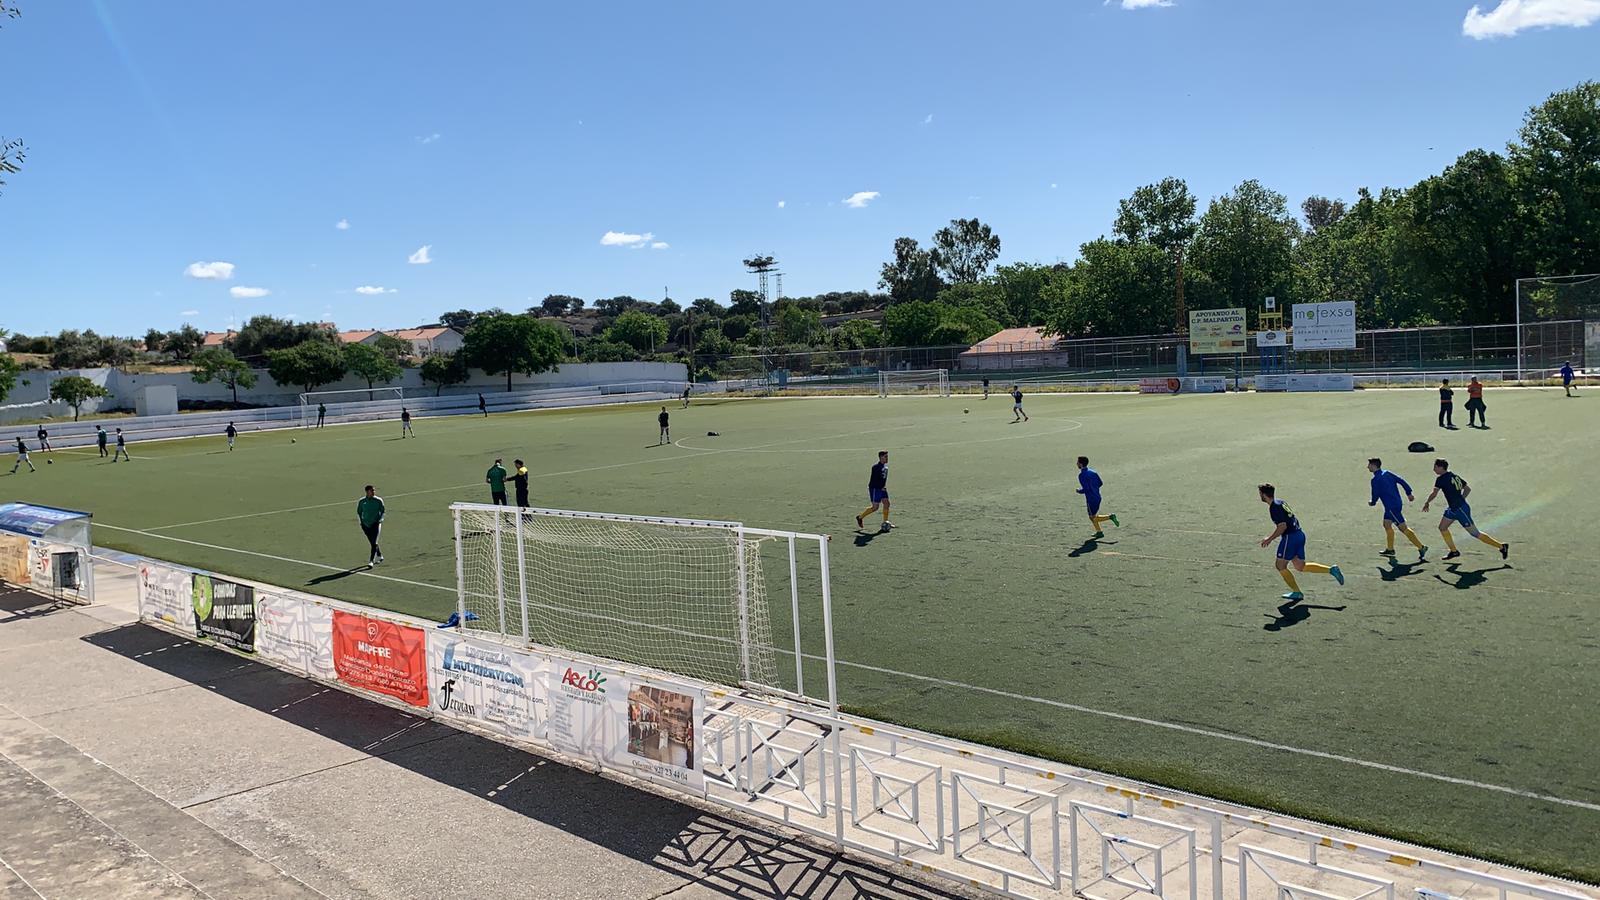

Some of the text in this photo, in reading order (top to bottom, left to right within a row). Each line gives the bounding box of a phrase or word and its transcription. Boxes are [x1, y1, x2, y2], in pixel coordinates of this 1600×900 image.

[1296, 304, 1353, 325] mofexsa
[358, 640, 392, 659] MAPFRE
[653, 765, 664, 774] 927
[664, 768, 673, 777] 23
[673, 770, 681, 778] 44
[681, 772, 688, 780] 04
